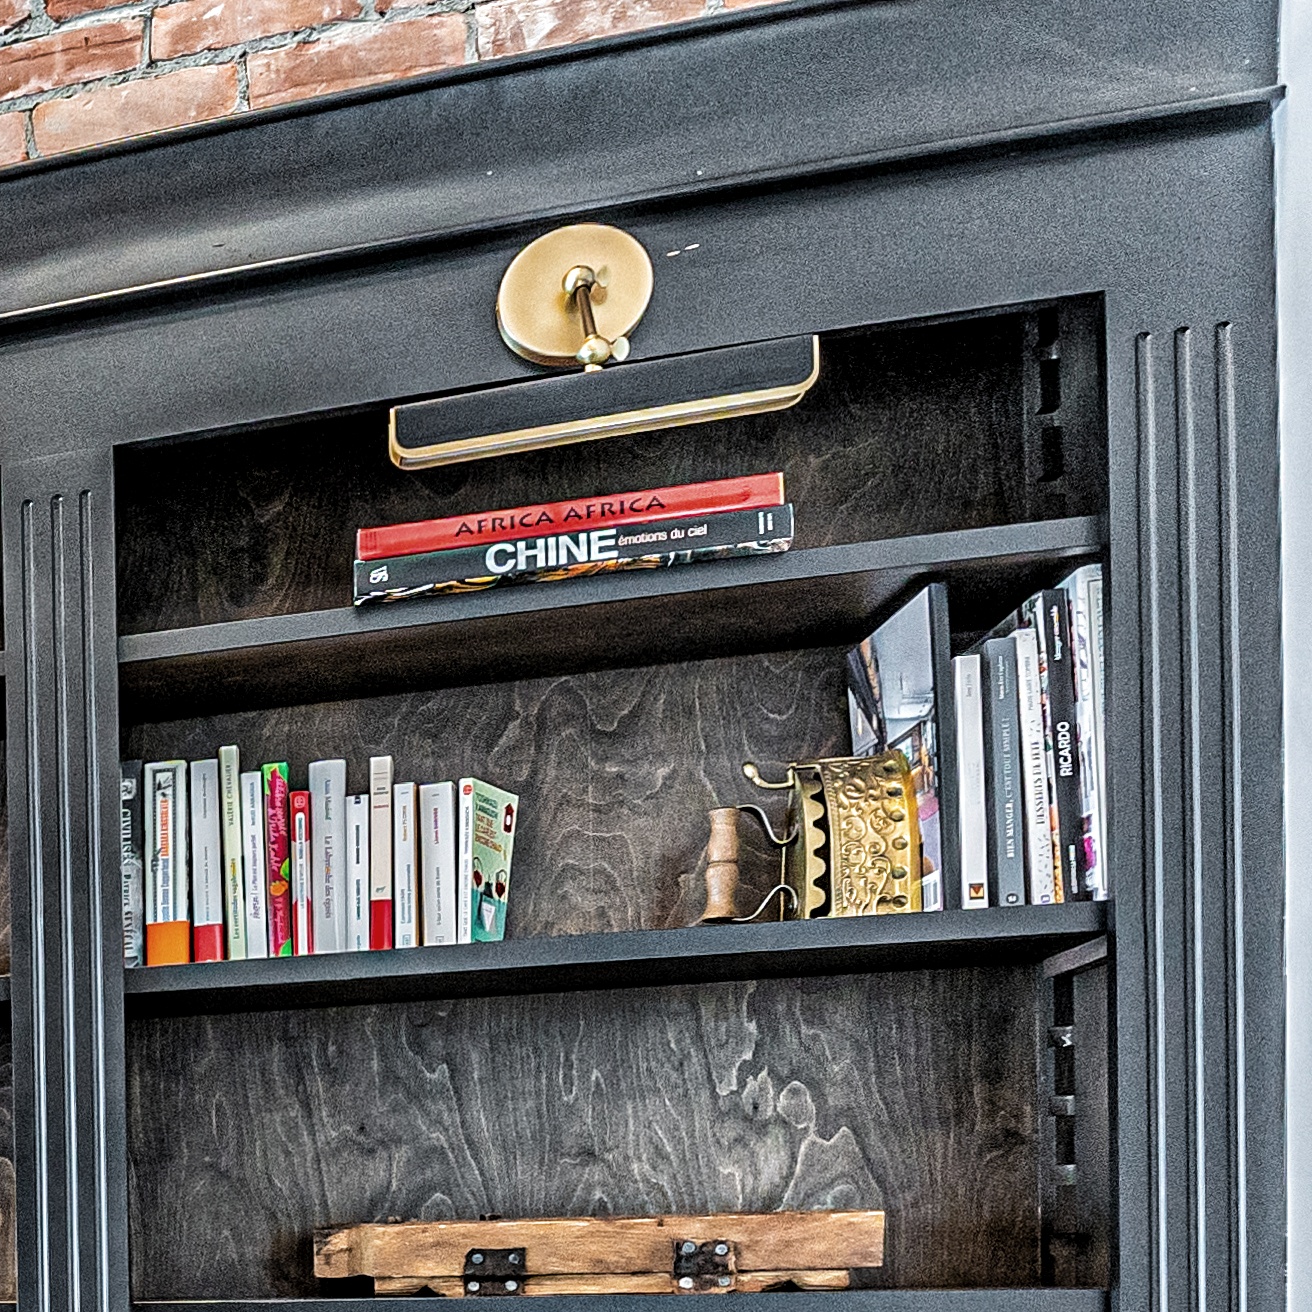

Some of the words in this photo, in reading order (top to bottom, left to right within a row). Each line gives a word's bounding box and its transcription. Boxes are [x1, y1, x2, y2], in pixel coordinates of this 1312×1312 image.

[455, 510, 554, 537] AFRICA
[563, 496, 667, 521] AFRICA
[485, 528, 618, 574] CHINE
[618, 530, 668, 546] émotions
[670, 527, 686, 540] du
[687, 524, 708, 538] ciel
[1057, 721, 1074, 776] RICARDO
